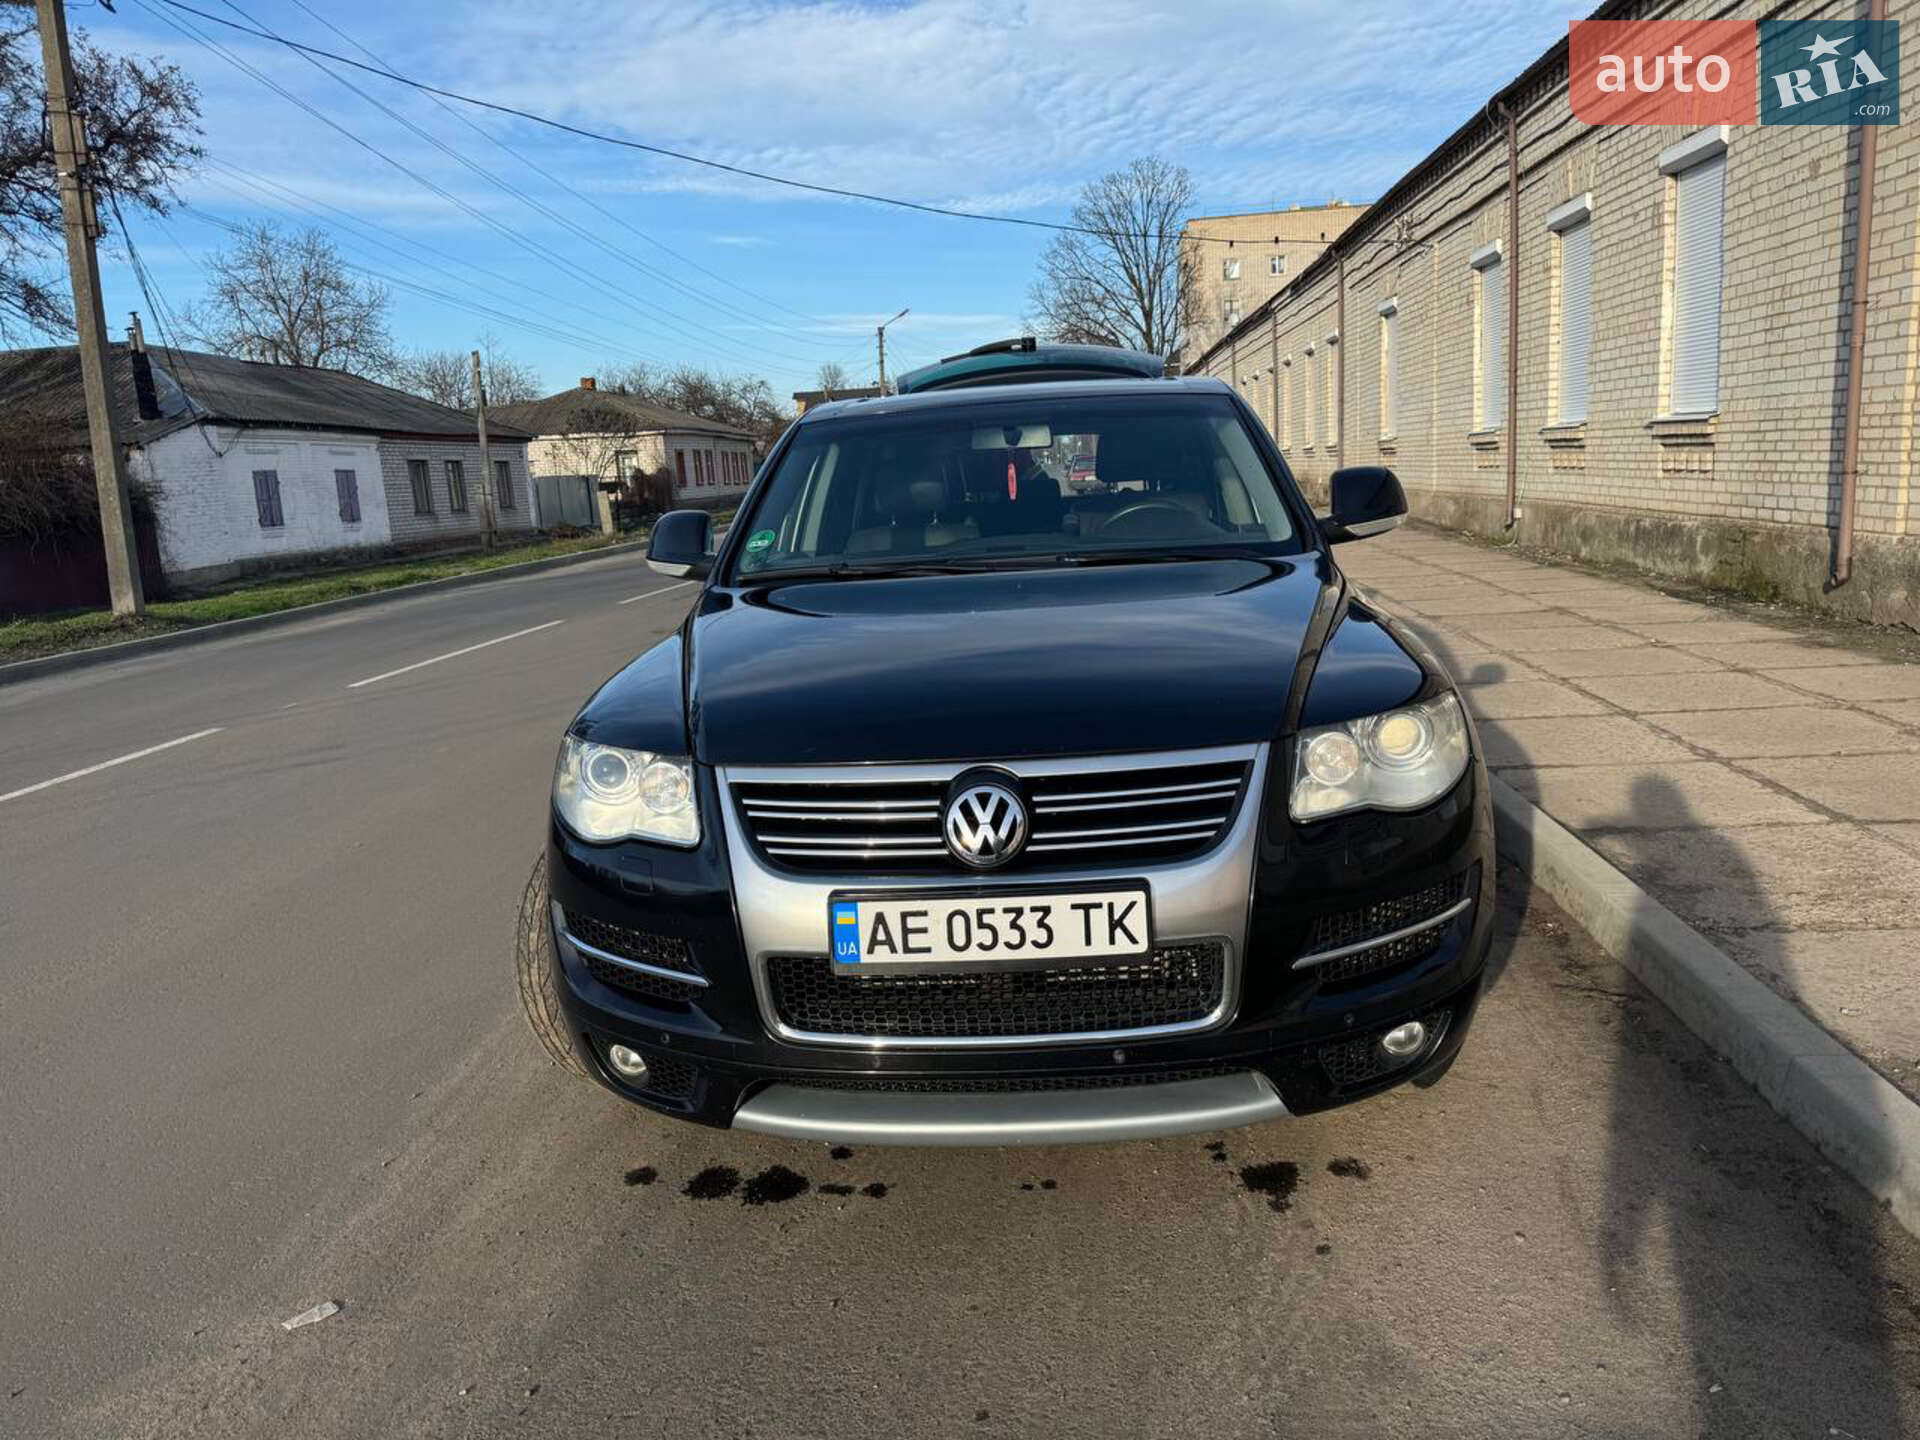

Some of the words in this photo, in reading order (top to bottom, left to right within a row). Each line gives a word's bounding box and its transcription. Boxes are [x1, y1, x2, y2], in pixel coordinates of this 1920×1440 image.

[866, 911, 932, 955] AE
[946, 905, 1054, 953] 0533
[1070, 900, 1140, 947] TK
[838, 941, 857, 956] UA
